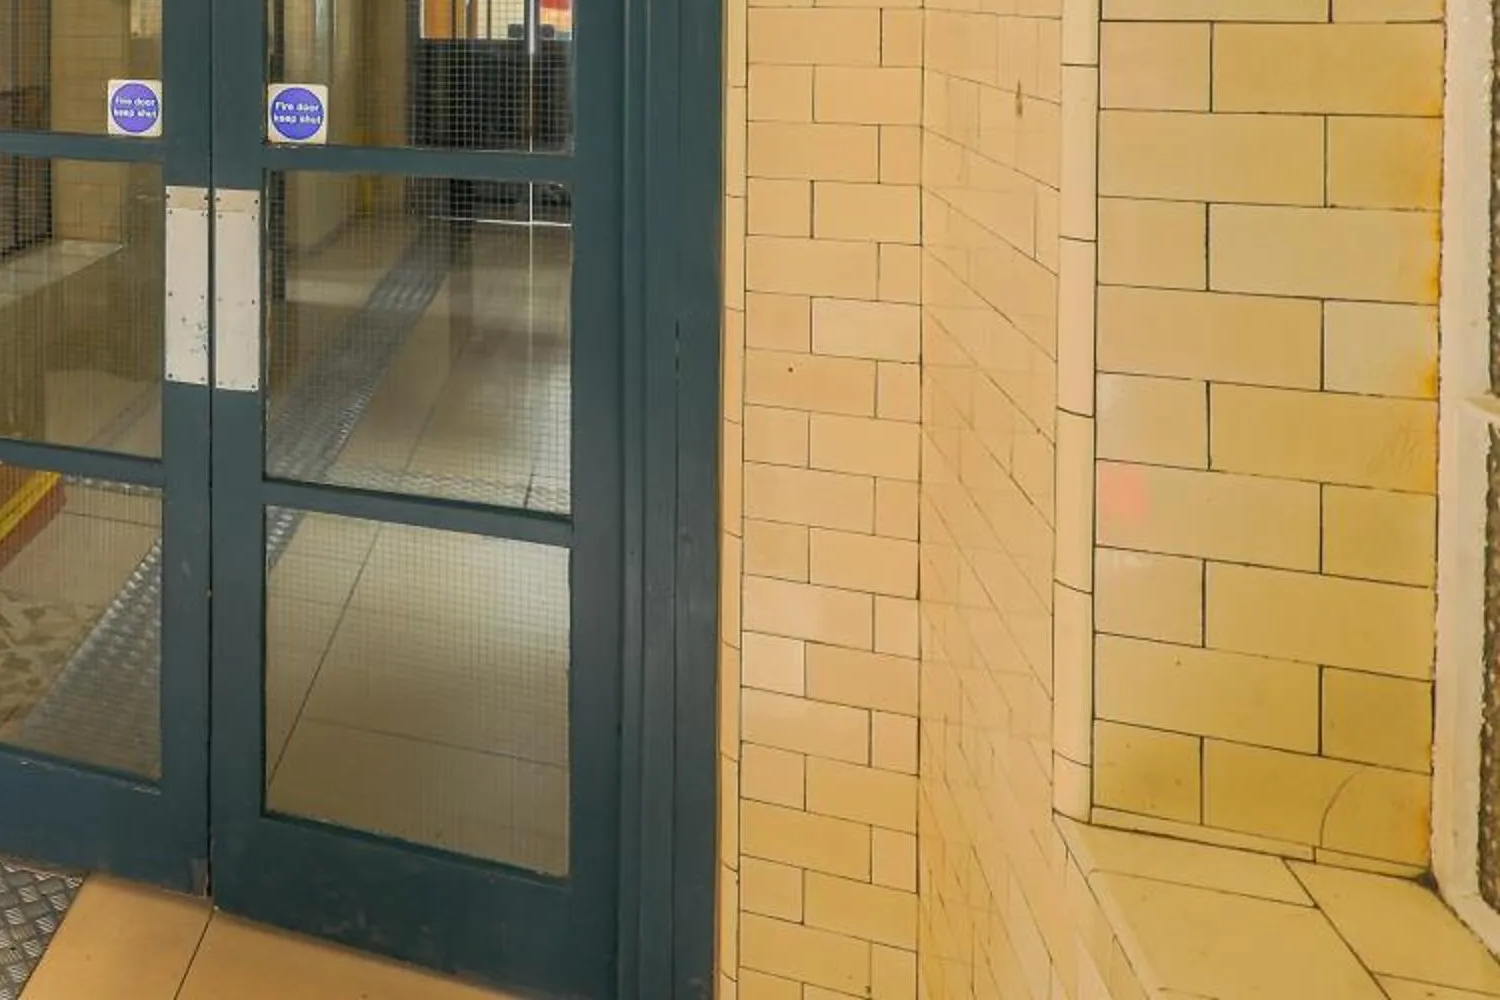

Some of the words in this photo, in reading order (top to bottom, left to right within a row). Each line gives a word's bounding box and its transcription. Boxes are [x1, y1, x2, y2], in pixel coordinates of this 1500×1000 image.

[134, 97, 156, 107] door
[275, 102, 294, 111] Fire
[296, 103, 320, 112] door
[113, 108, 135, 119] keep
[137, 108, 157, 118] shut
[274, 114, 297, 124] keep
[299, 114, 322, 125] shut
